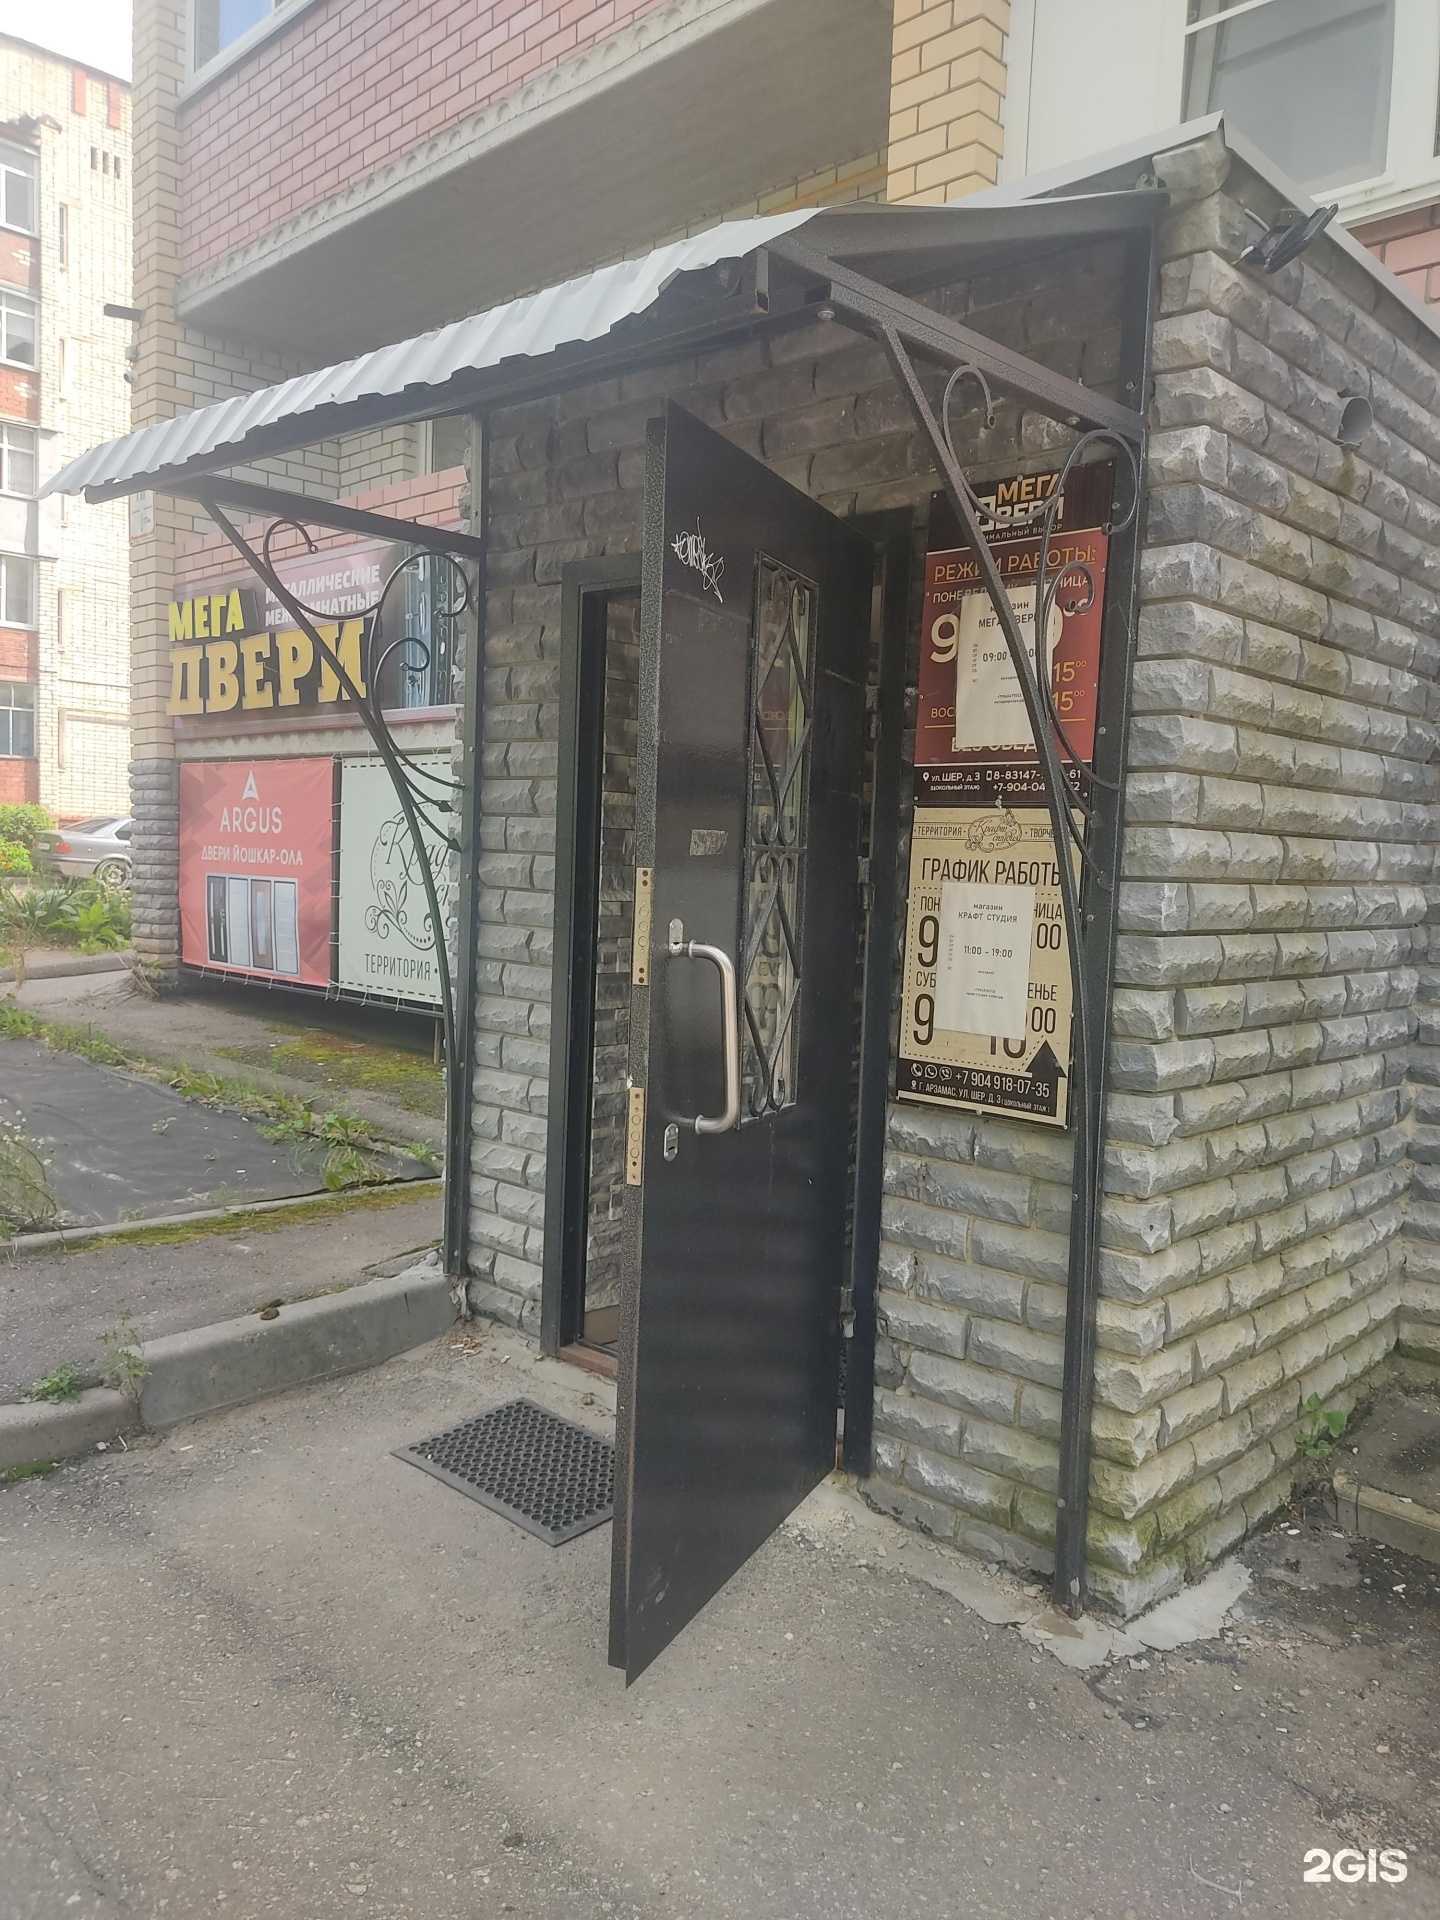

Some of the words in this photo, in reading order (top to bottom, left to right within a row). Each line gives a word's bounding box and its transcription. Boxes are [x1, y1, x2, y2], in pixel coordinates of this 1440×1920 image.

[265, 565, 380, 604] МТАЛЛИЧЕСКИЕ
[168, 588, 245, 642] МЕГА
[166, 618, 367, 716] ДВЕРИ
[982, 651, 1008, 663] 09:00
[219, 807, 283, 834] ARGUS
[917, 826, 962, 836] ТЕРРИТОРИЯ
[200, 845, 231, 863] ДВЕРИ
[232, 845, 303, 866] ЙОШКАР-ОЛА
[921, 858, 991, 883] ГРАФИК
[958, 911, 984, 921] КРАФТ
[986, 913, 1018, 923] СТУДИЯ
[973, 903, 1003, 911] магазин
[964, 945, 982, 955] 11:00
[991, 948, 1013, 958] 19:00
[364, 953, 431, 981] ТЕРРИТОРИЯ
